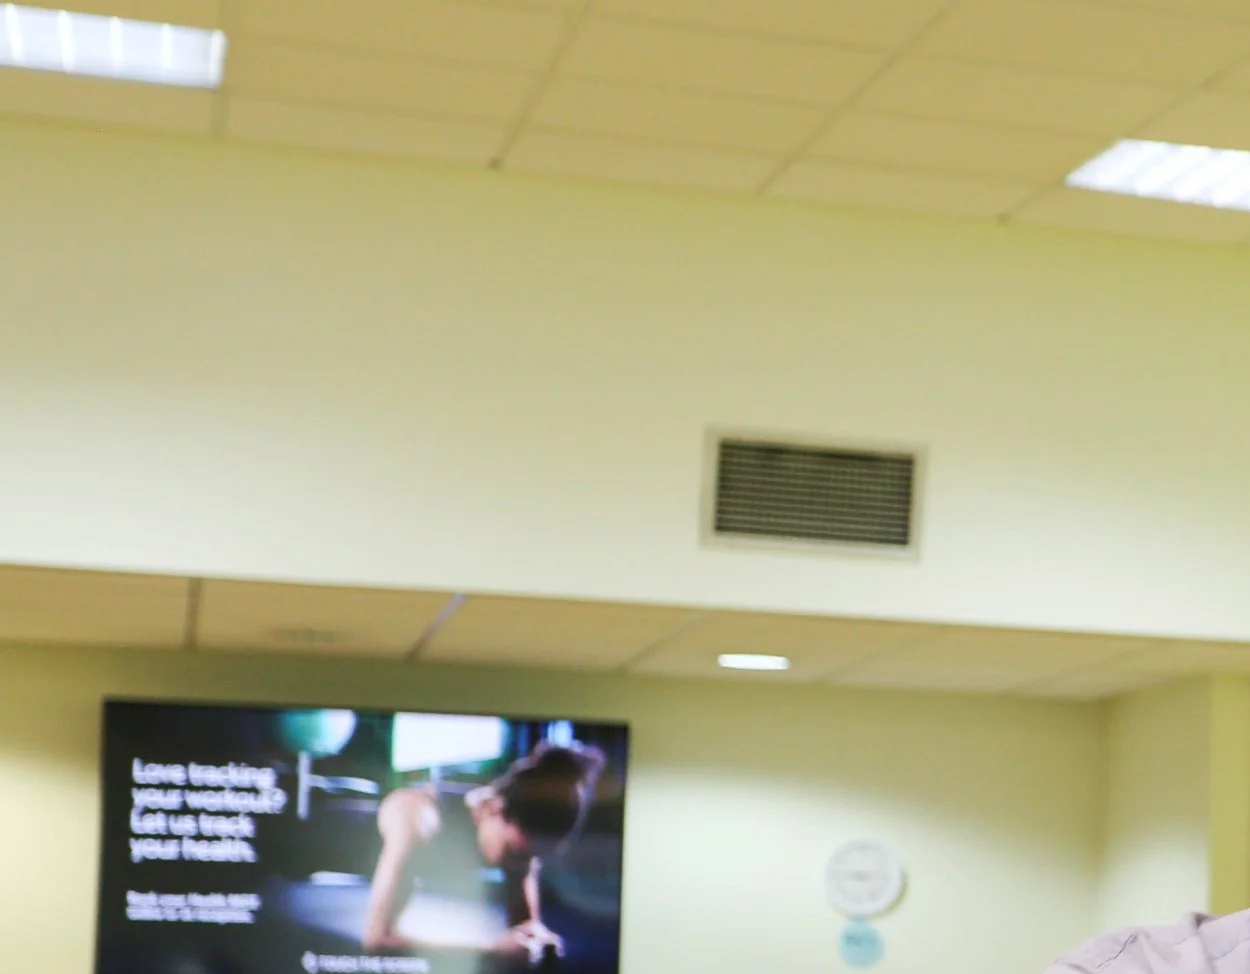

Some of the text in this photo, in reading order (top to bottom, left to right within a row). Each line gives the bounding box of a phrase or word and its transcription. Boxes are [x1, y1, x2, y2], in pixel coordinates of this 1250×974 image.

[132, 757, 277, 790] Love tracking
[131, 787, 288, 815] your workout?
[130, 807, 257, 838] Let us track
[129, 837, 180, 864] your
